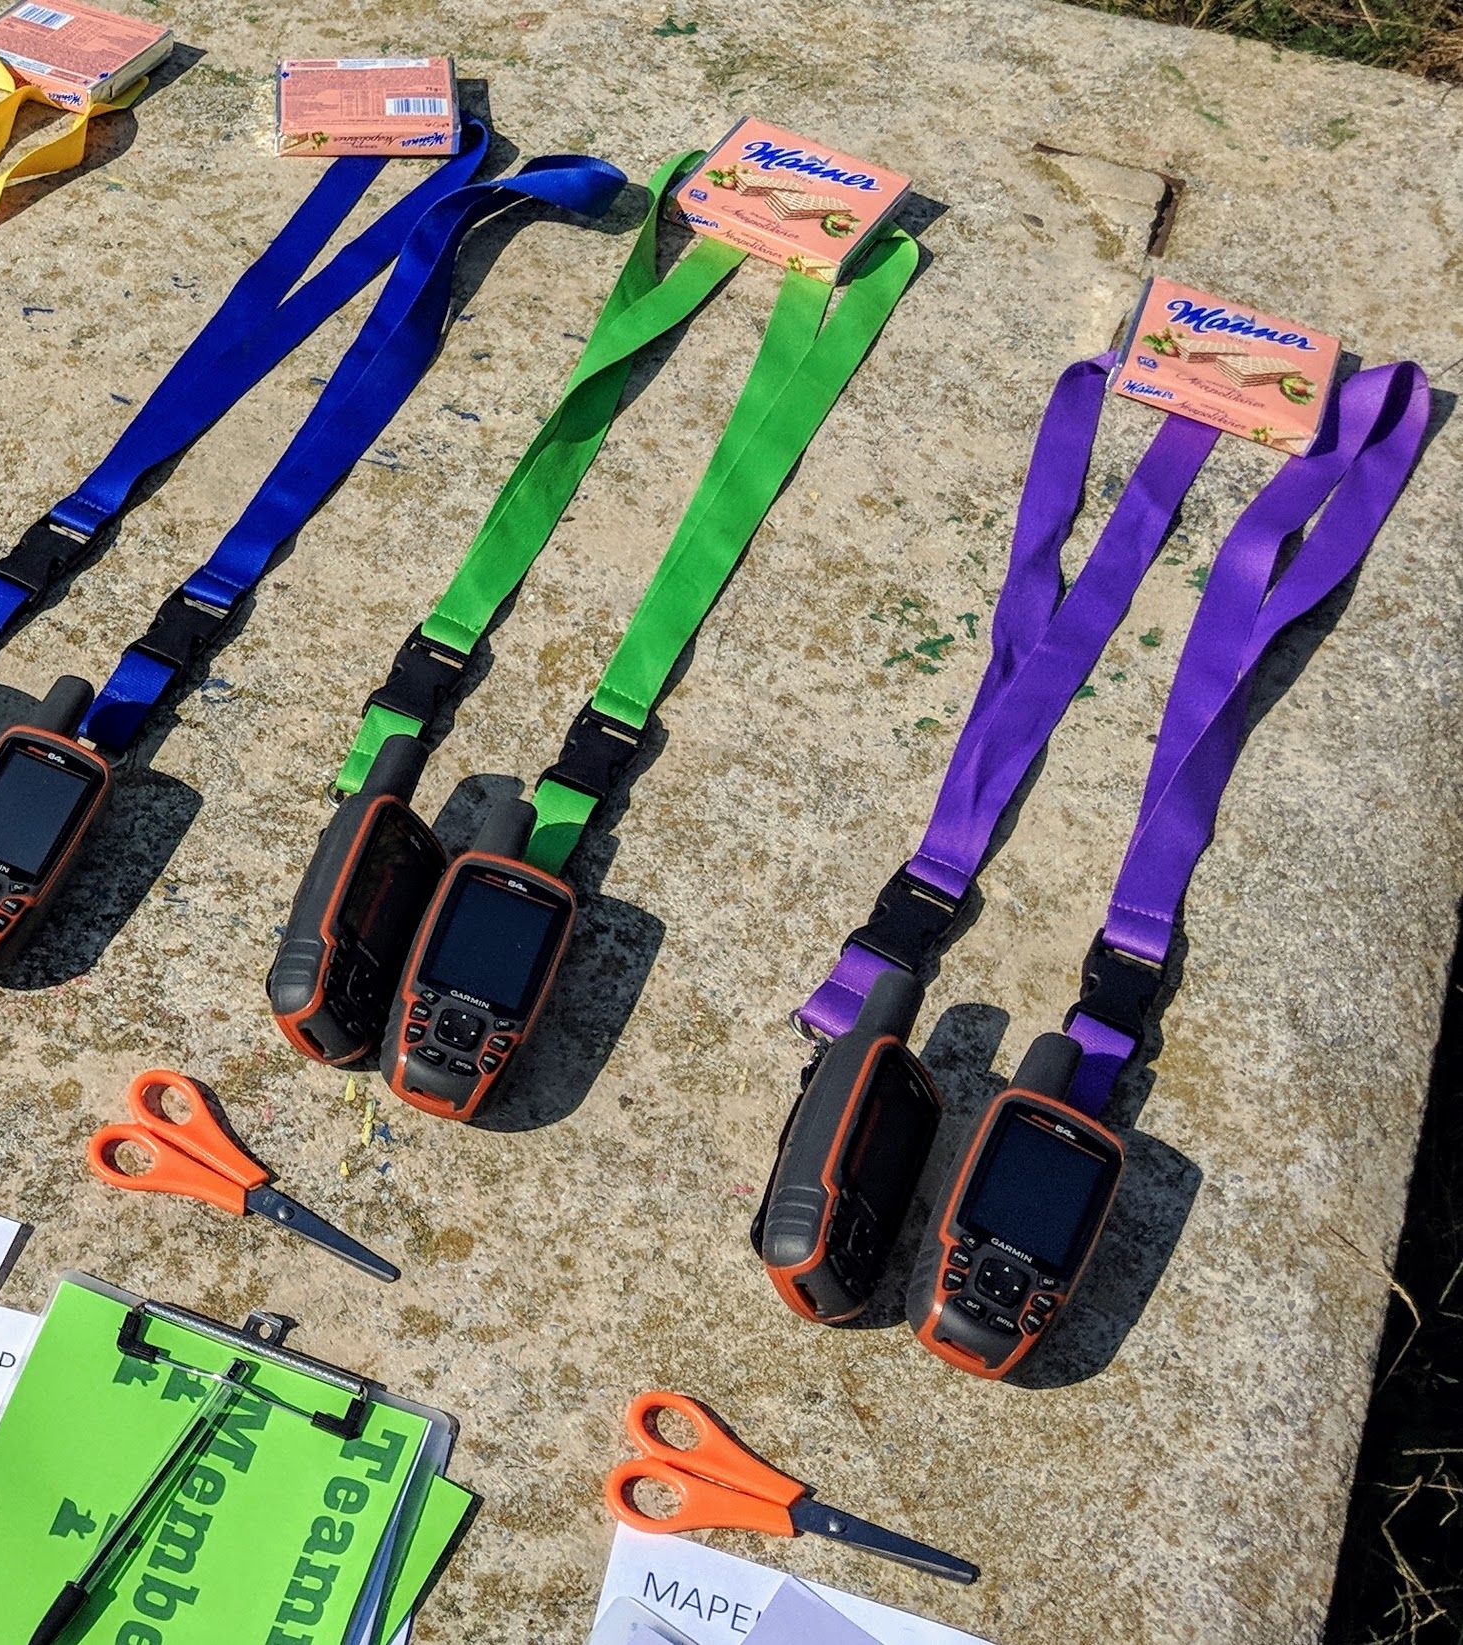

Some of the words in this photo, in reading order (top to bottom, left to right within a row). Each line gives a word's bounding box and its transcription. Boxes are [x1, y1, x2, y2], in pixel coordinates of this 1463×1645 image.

[399, 132, 448, 148] Manner
[740, 140, 883, 192] Manner
[676, 210, 721, 230] Manner
[1166, 299, 1317, 351] Manner
[1122, 379, 1176, 400] Manner
[450, 989, 491, 1010] GARMIN
[990, 1237, 1033, 1264] GARMIN
[995, 1316, 1015, 1329] ENTER
